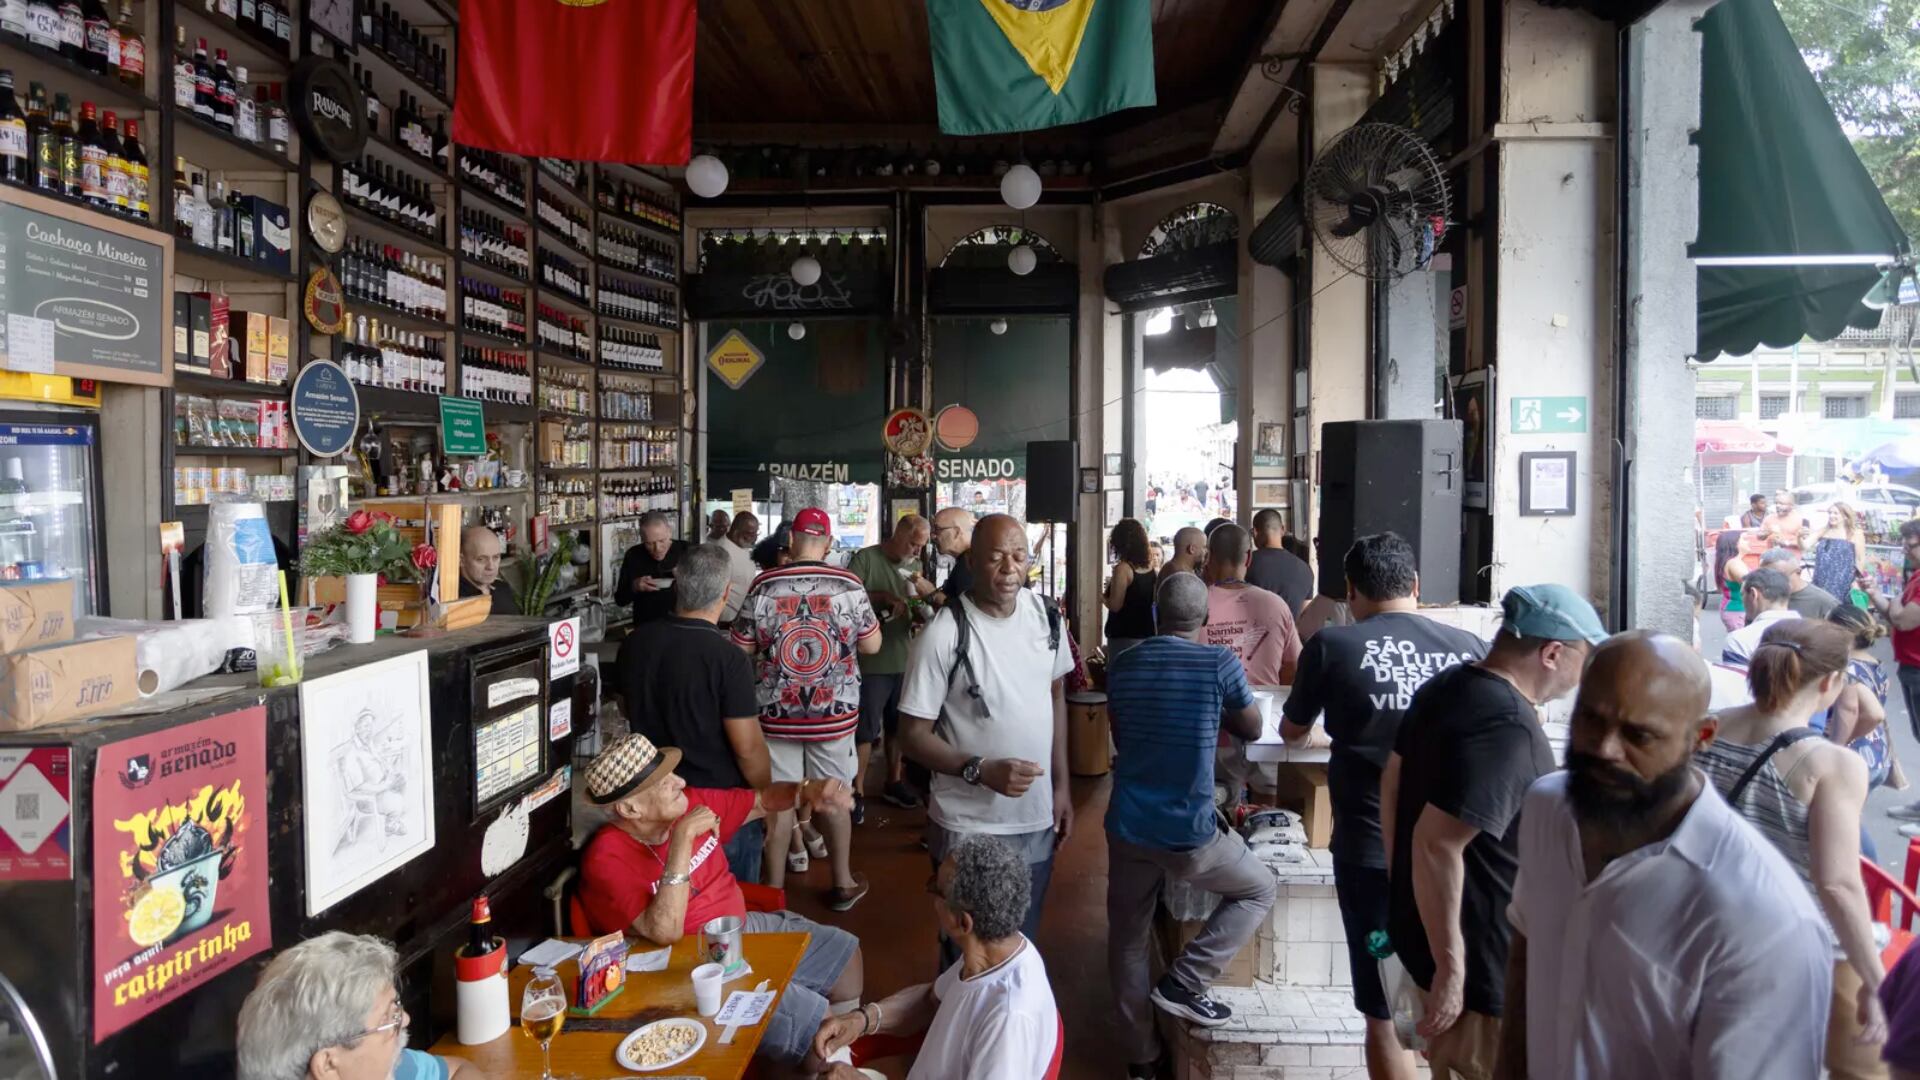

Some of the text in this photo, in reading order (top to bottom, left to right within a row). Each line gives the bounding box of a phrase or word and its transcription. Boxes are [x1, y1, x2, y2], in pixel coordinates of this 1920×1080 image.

[26, 222, 93, 256] Cachaça
[97, 240, 148, 267] Mineira
[52, 304, 130, 327] ARMAZÉM SENADO
[938, 459, 1014, 478] SENADO
[1207, 626, 1243, 636] bamba
[1365, 635, 1416, 655] SÃO
[1360, 653, 1393, 669] AS
[161, 738, 211, 758] armazém
[160, 741, 236, 778] senado
[114, 920, 252, 1006] caipirinha
[103, 961, 132, 987] peça
